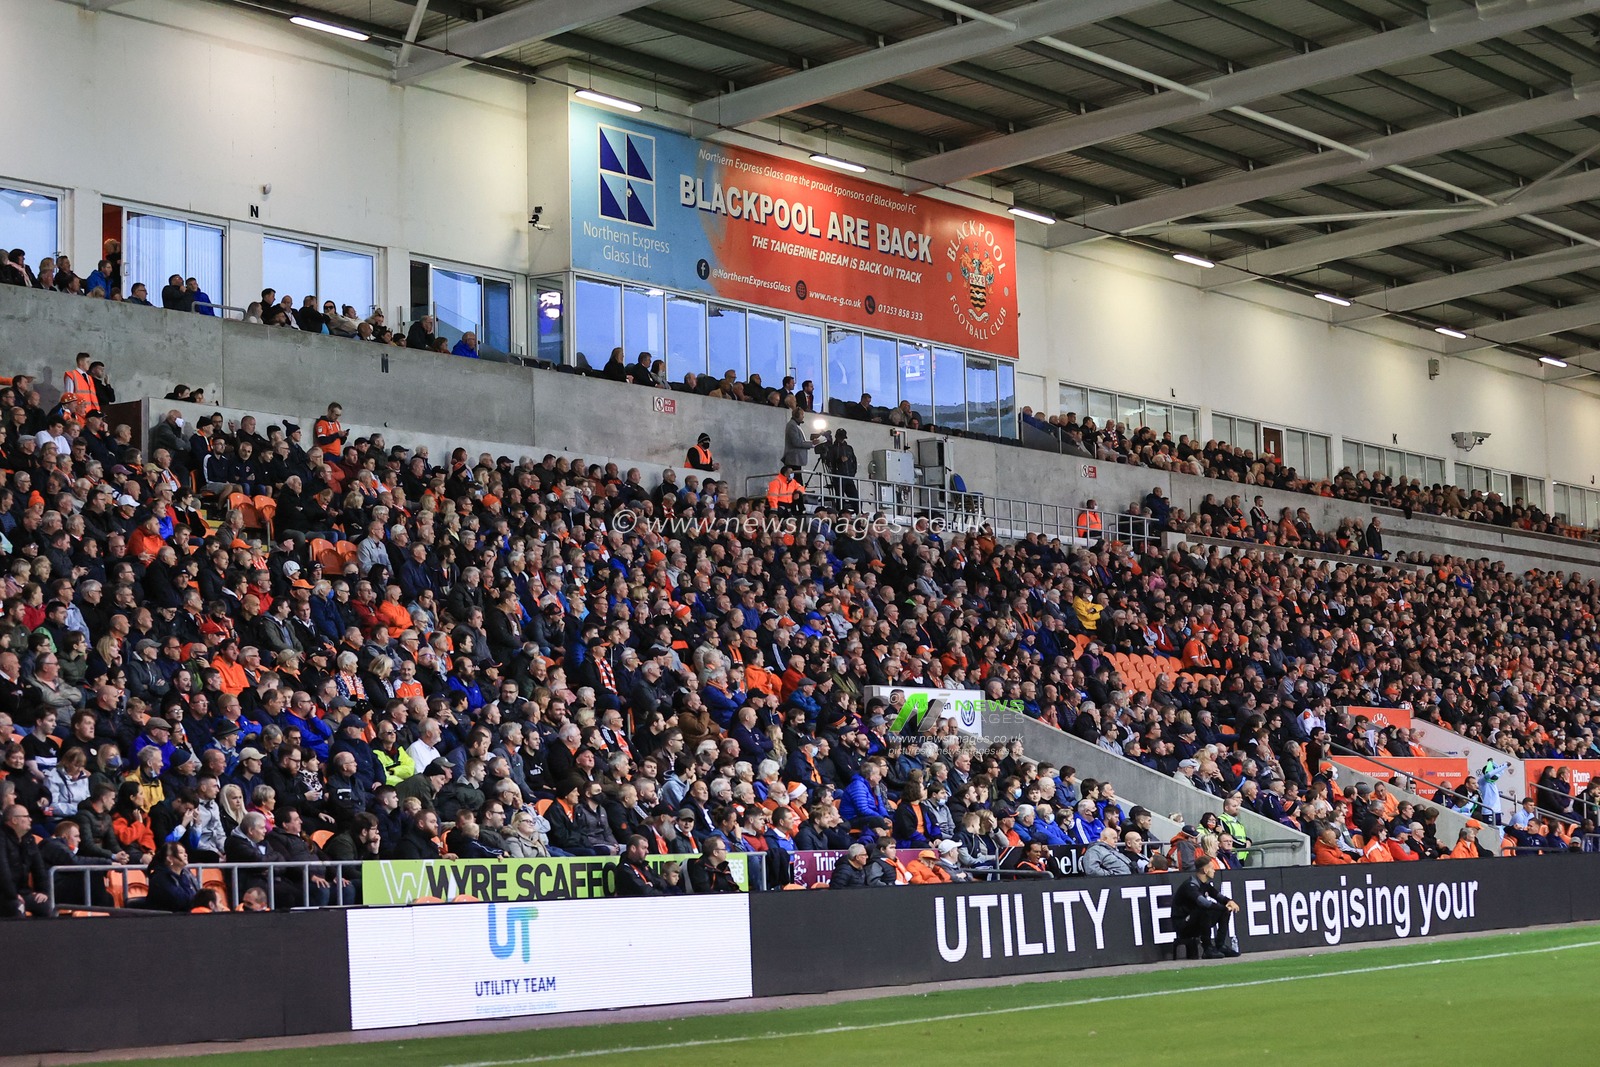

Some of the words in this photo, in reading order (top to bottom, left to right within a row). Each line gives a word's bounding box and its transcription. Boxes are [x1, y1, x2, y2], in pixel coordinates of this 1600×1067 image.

[699, 149, 734, 168] Northern
[735, 158, 763, 177] Express
[763, 166, 784, 181] Glass
[784, 173, 799, 184] are
[799, 175, 811, 188] the
[811, 178, 833, 194] proud
[833, 185, 865, 202] sponsors
[865, 189, 875, 203] of
[874, 193, 908, 213] Blackpool
[908, 203, 918, 215] FC
[250, 204, 259, 219] N
[679, 174, 822, 238] BLACKPOOL
[827, 211, 870, 250] ARE
[875, 223, 934, 264] BACK
[583, 220, 630, 246] Northern
[632, 231, 670, 254] Express
[946, 219, 1006, 274] BLACKPOOL
[603, 244, 630, 265] Glass
[632, 252, 652, 269] Ltd.
[752, 235, 768, 250] THE
[770, 239, 819, 261] TANGERINE
[819, 250, 849, 268] DREAM
[859, 258, 882, 275] BACK
[882, 264, 895, 278] ON
[896, 267, 923, 284] TRACK
[809, 289, 862, 308] www.n-e-g.co.uk
[877, 303, 898, 316] 01253
[898, 306, 910, 319] 858
[910, 309, 924, 321] 333
[950, 294, 988, 340] FOOTBALL
[989, 307, 1007, 336] CLUB
[1572, 769, 1591, 783] Home
[426, 863, 508, 901] WYRE
[516, 861, 618, 900] SCAFFO
[934, 887, 1110, 963] UTILITY
[1244, 874, 1411, 946] Energising
[1417, 879, 1478, 936] your
[475, 978, 520, 997] UTILITY
[523, 976, 556, 993] TEAM
